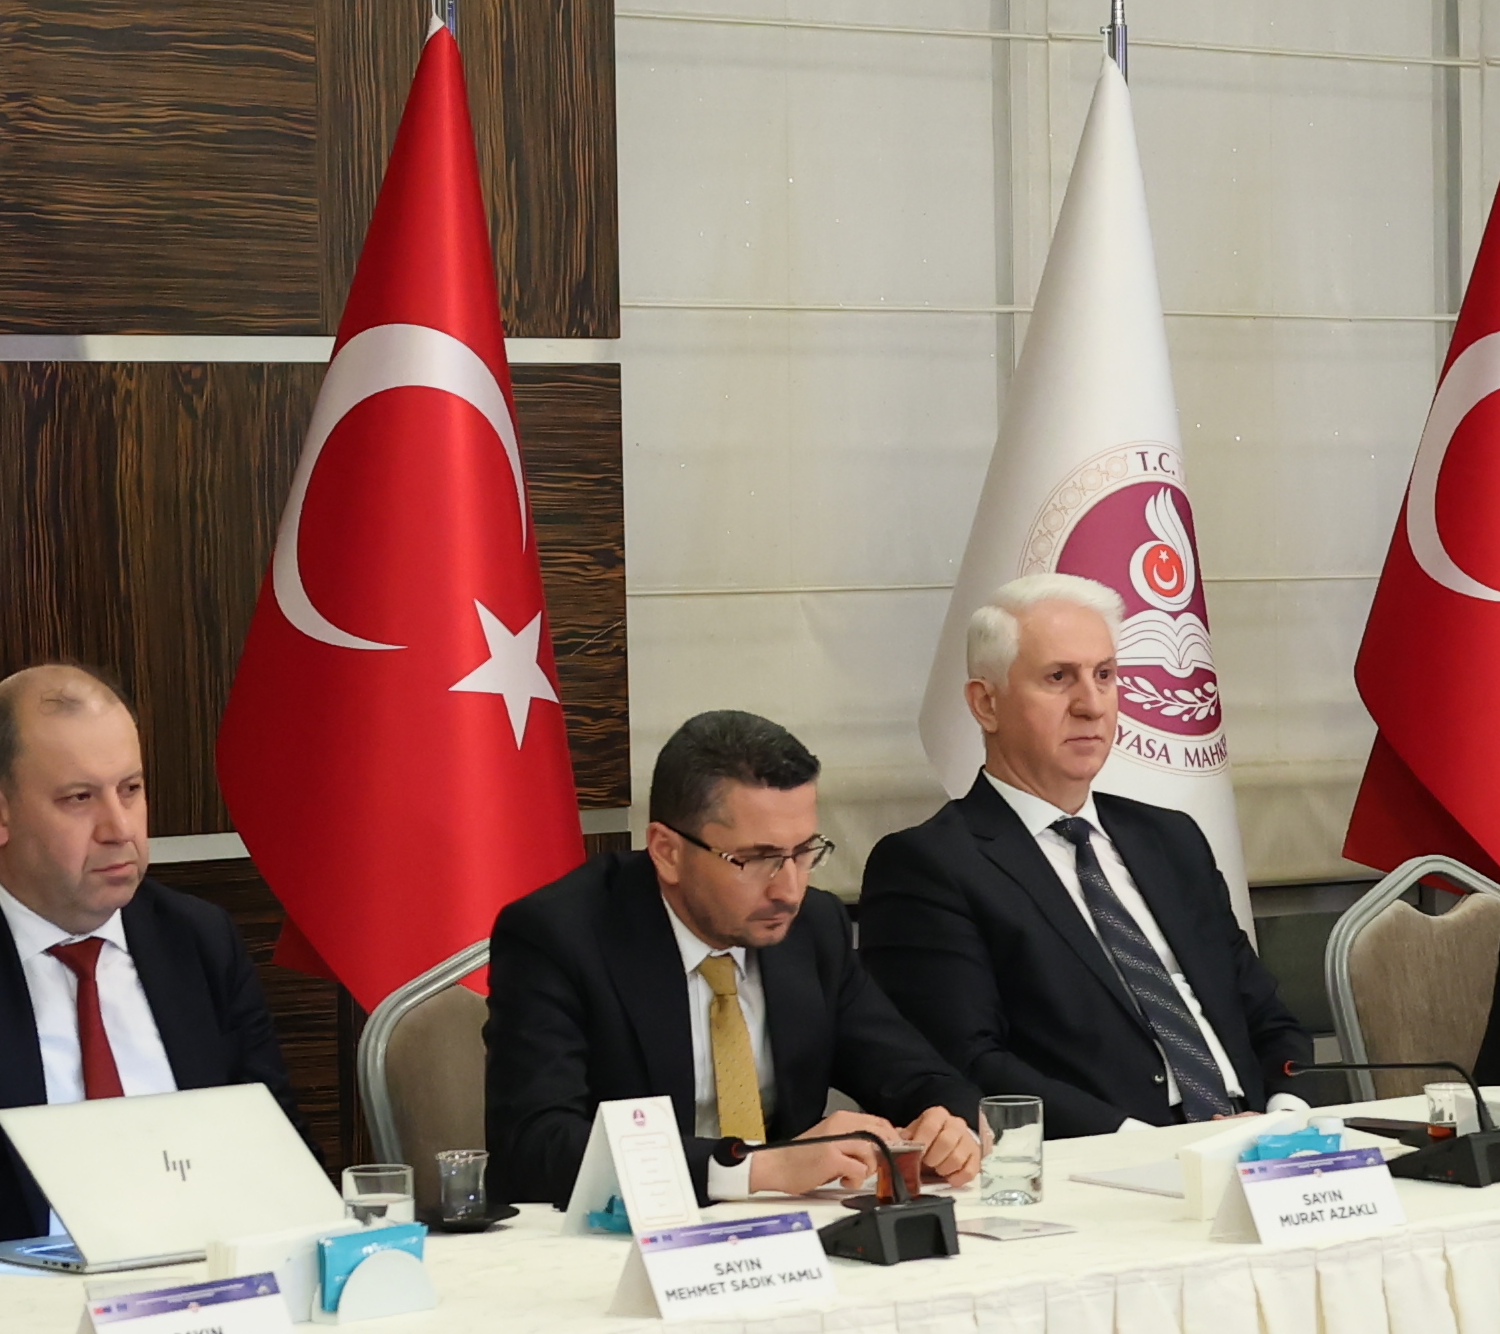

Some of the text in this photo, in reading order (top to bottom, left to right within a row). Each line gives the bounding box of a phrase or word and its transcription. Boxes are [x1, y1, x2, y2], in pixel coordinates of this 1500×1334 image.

[1136, 451, 1176, 475] T.C.
[1303, 1189, 1344, 1207] SAYIN
[1279, 1202, 1379, 1228] MURAT AZAKLI
[713, 1258, 763, 1276] SAYIN
[665, 1281, 727, 1302] MEHMET
[730, 1274, 776, 1292] SADIK
